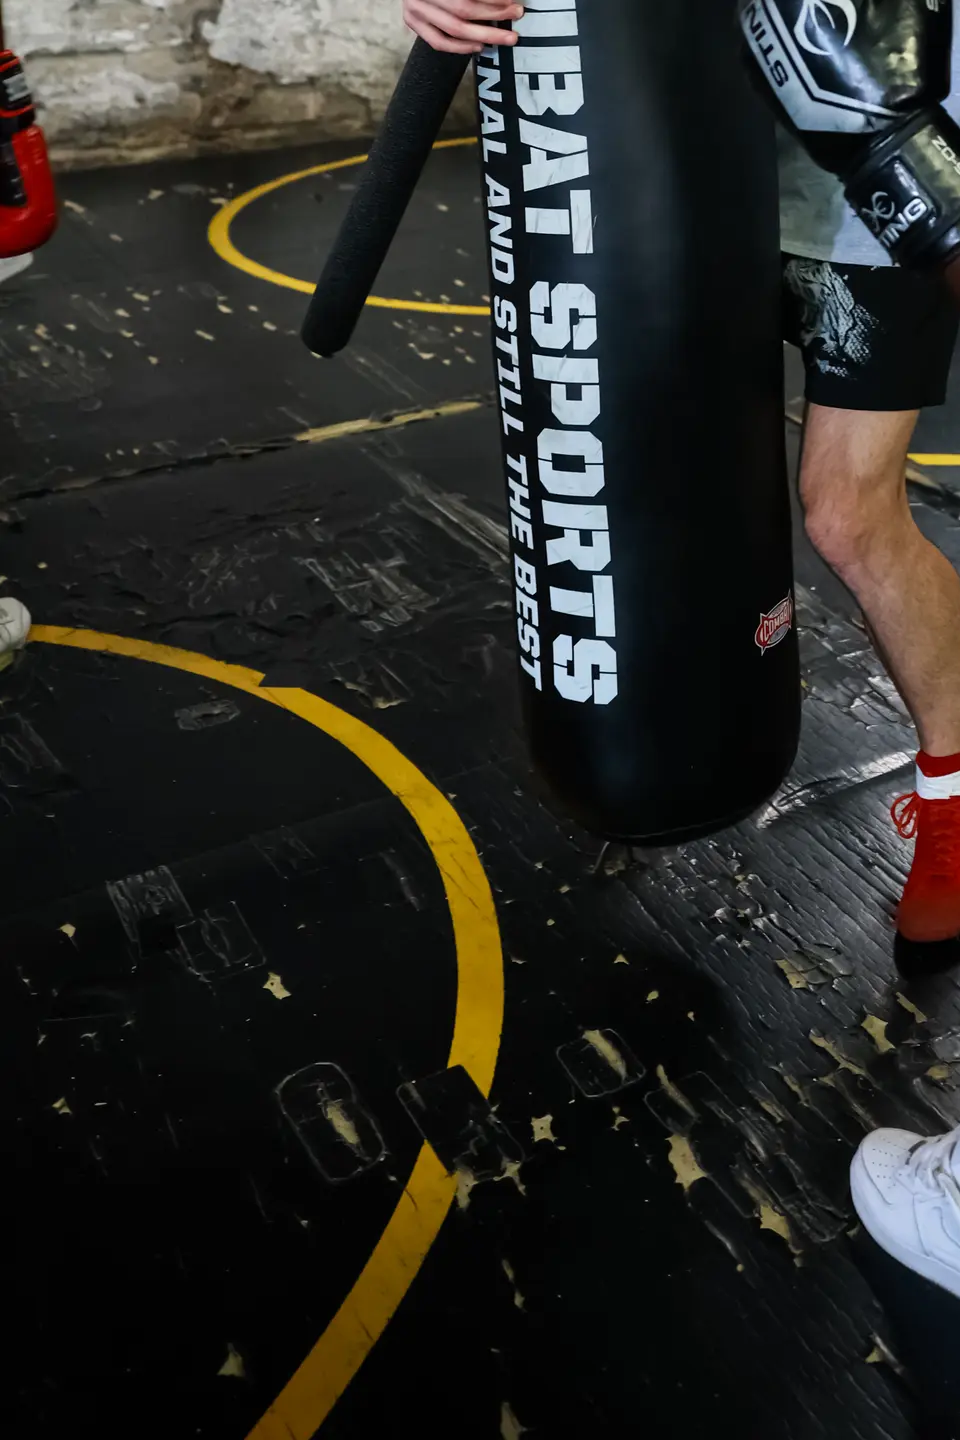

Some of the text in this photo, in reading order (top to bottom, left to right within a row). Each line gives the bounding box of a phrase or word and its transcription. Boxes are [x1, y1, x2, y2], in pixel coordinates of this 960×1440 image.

[745, 1, 789, 88] STIN
[485, 173, 515, 285] AND
[879, 198, 927, 248] TING
[493, 295, 524, 436] STILL
[506, 453, 533, 550] THE
[529, 280, 618, 705] SPORTS
[513, 553, 542, 691] BEST
